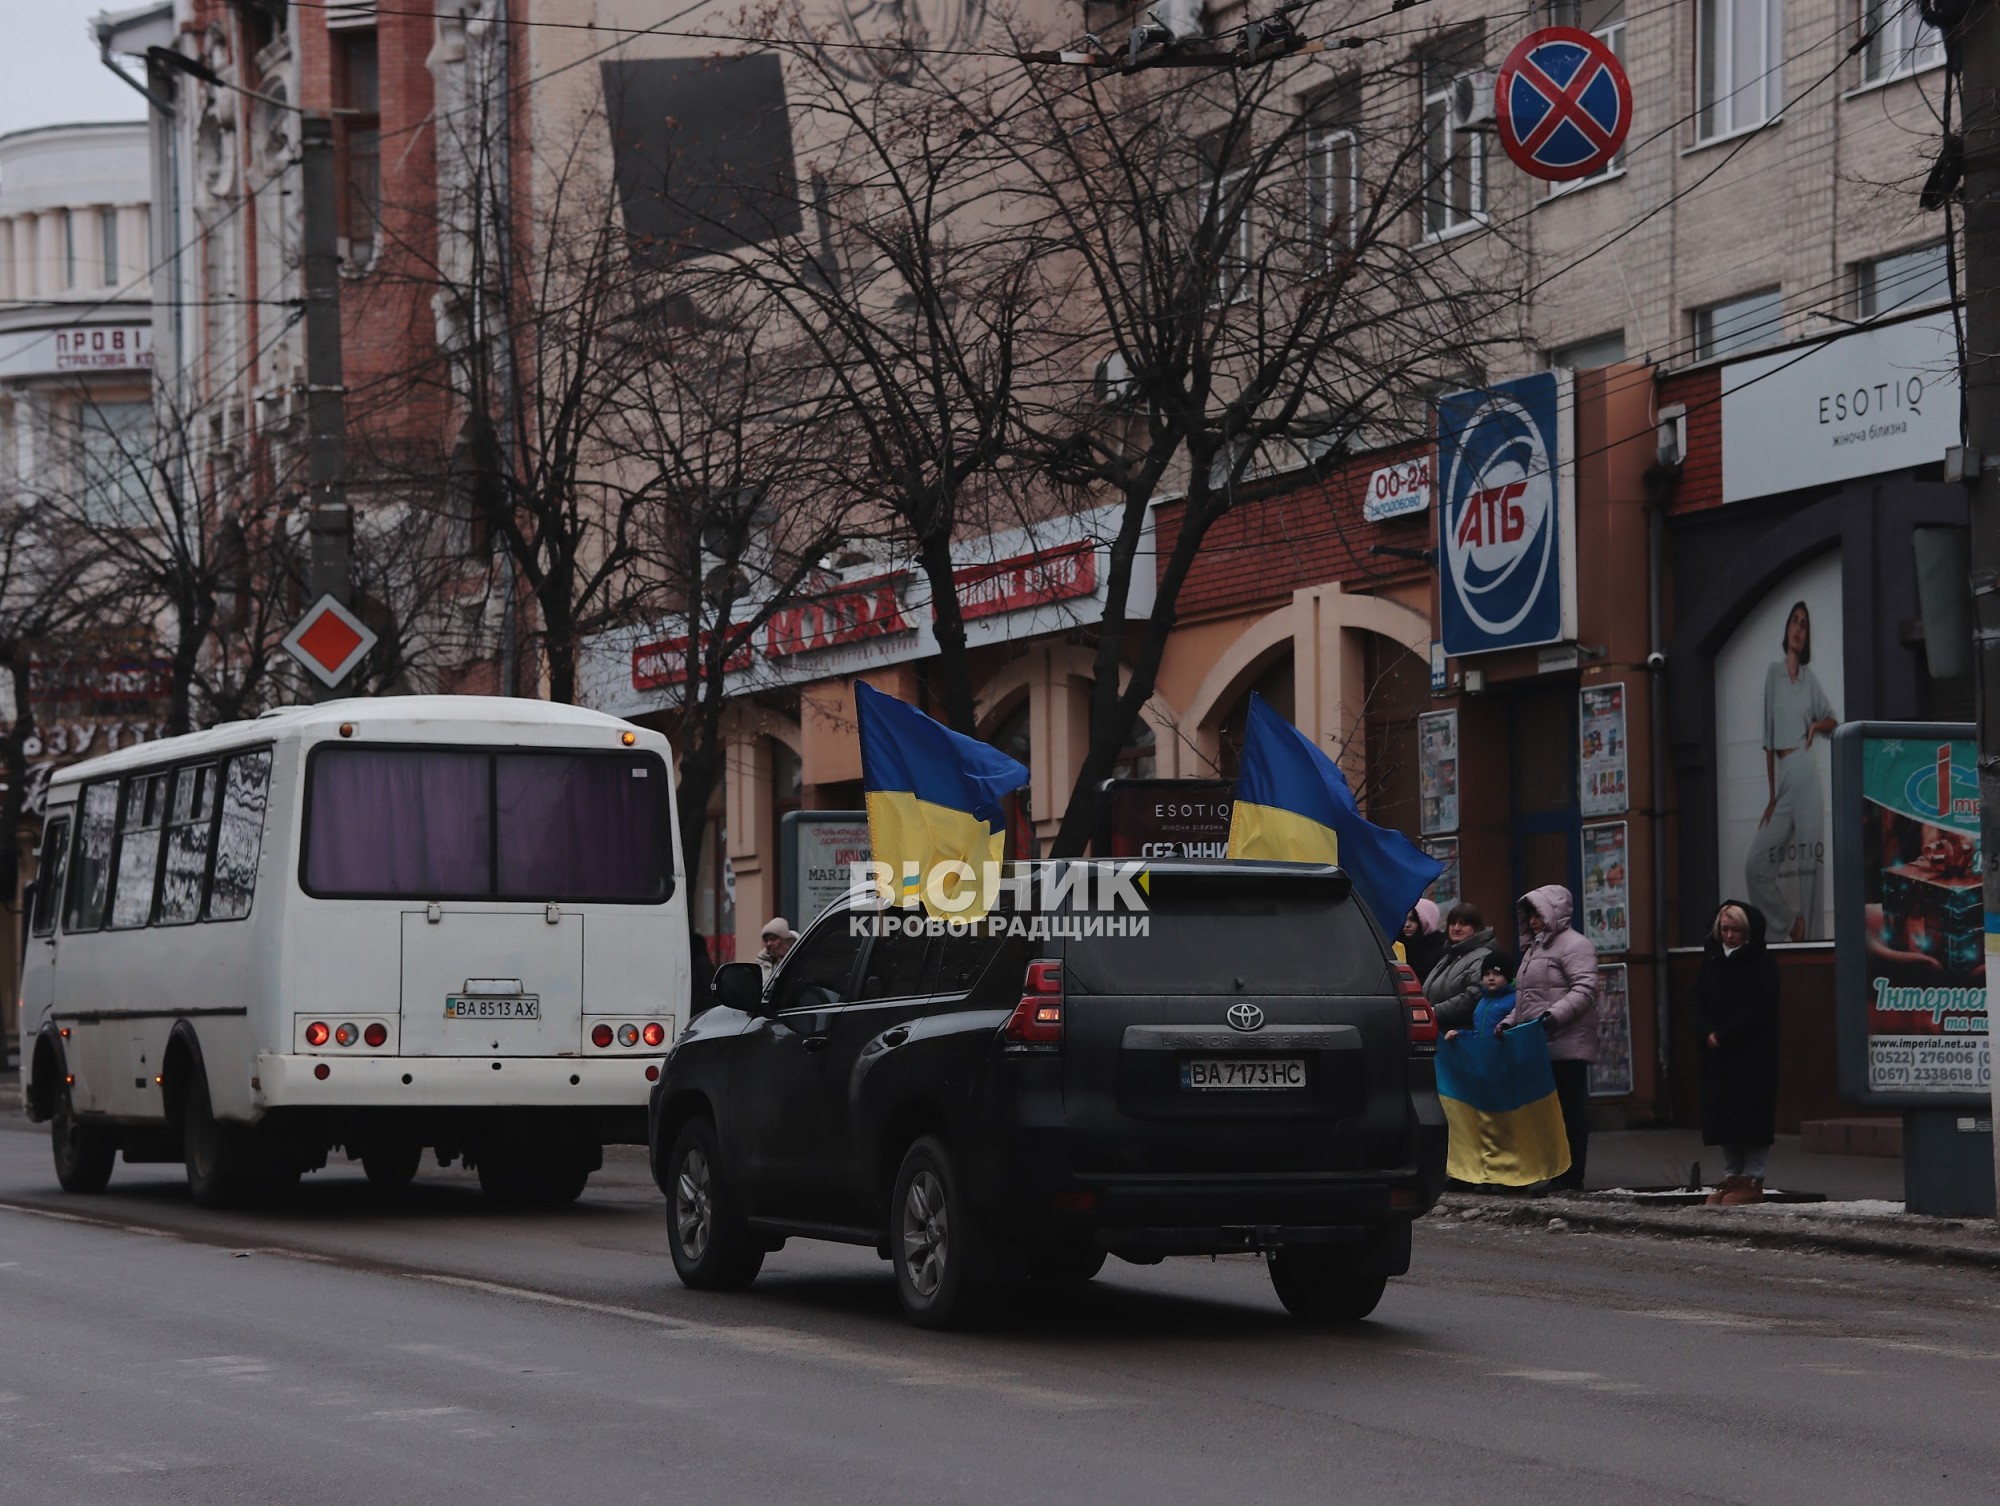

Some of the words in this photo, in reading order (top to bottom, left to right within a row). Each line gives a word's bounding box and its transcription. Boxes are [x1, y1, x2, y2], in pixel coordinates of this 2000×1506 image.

[1819, 377, 1922, 424] ESOTIQ
[1832, 431, 1866, 447] жіноча
[1869, 421, 1907, 440] білизна
[1376, 464, 1429, 499] 00-24
[1459, 482, 1528, 549] АТБ
[1154, 804, 1230, 821] ESOTIQ
[1769, 842, 1824, 865] ESOTIQ
[456, 1002, 476, 1015] BA
[480, 1002, 511, 1015] 8513
[515, 1002, 534, 1016] AX
[1163, 1036, 1204, 1047] LAND
[1282, 1035, 1331, 1046] PRADO
[1870, 1039, 1977, 1050] www.imperial.net.ua
[1871, 1051, 1915, 1066] (0522)
[1919, 1051, 1974, 1064] 276006
[1193, 1064, 1221, 1084] BA
[1225, 1063, 1268, 1084] 7173
[1273, 1063, 1301, 1084] HC
[1873, 1068, 1910, 1083] (067)
[1914, 1068, 1973, 1081] 2338618
